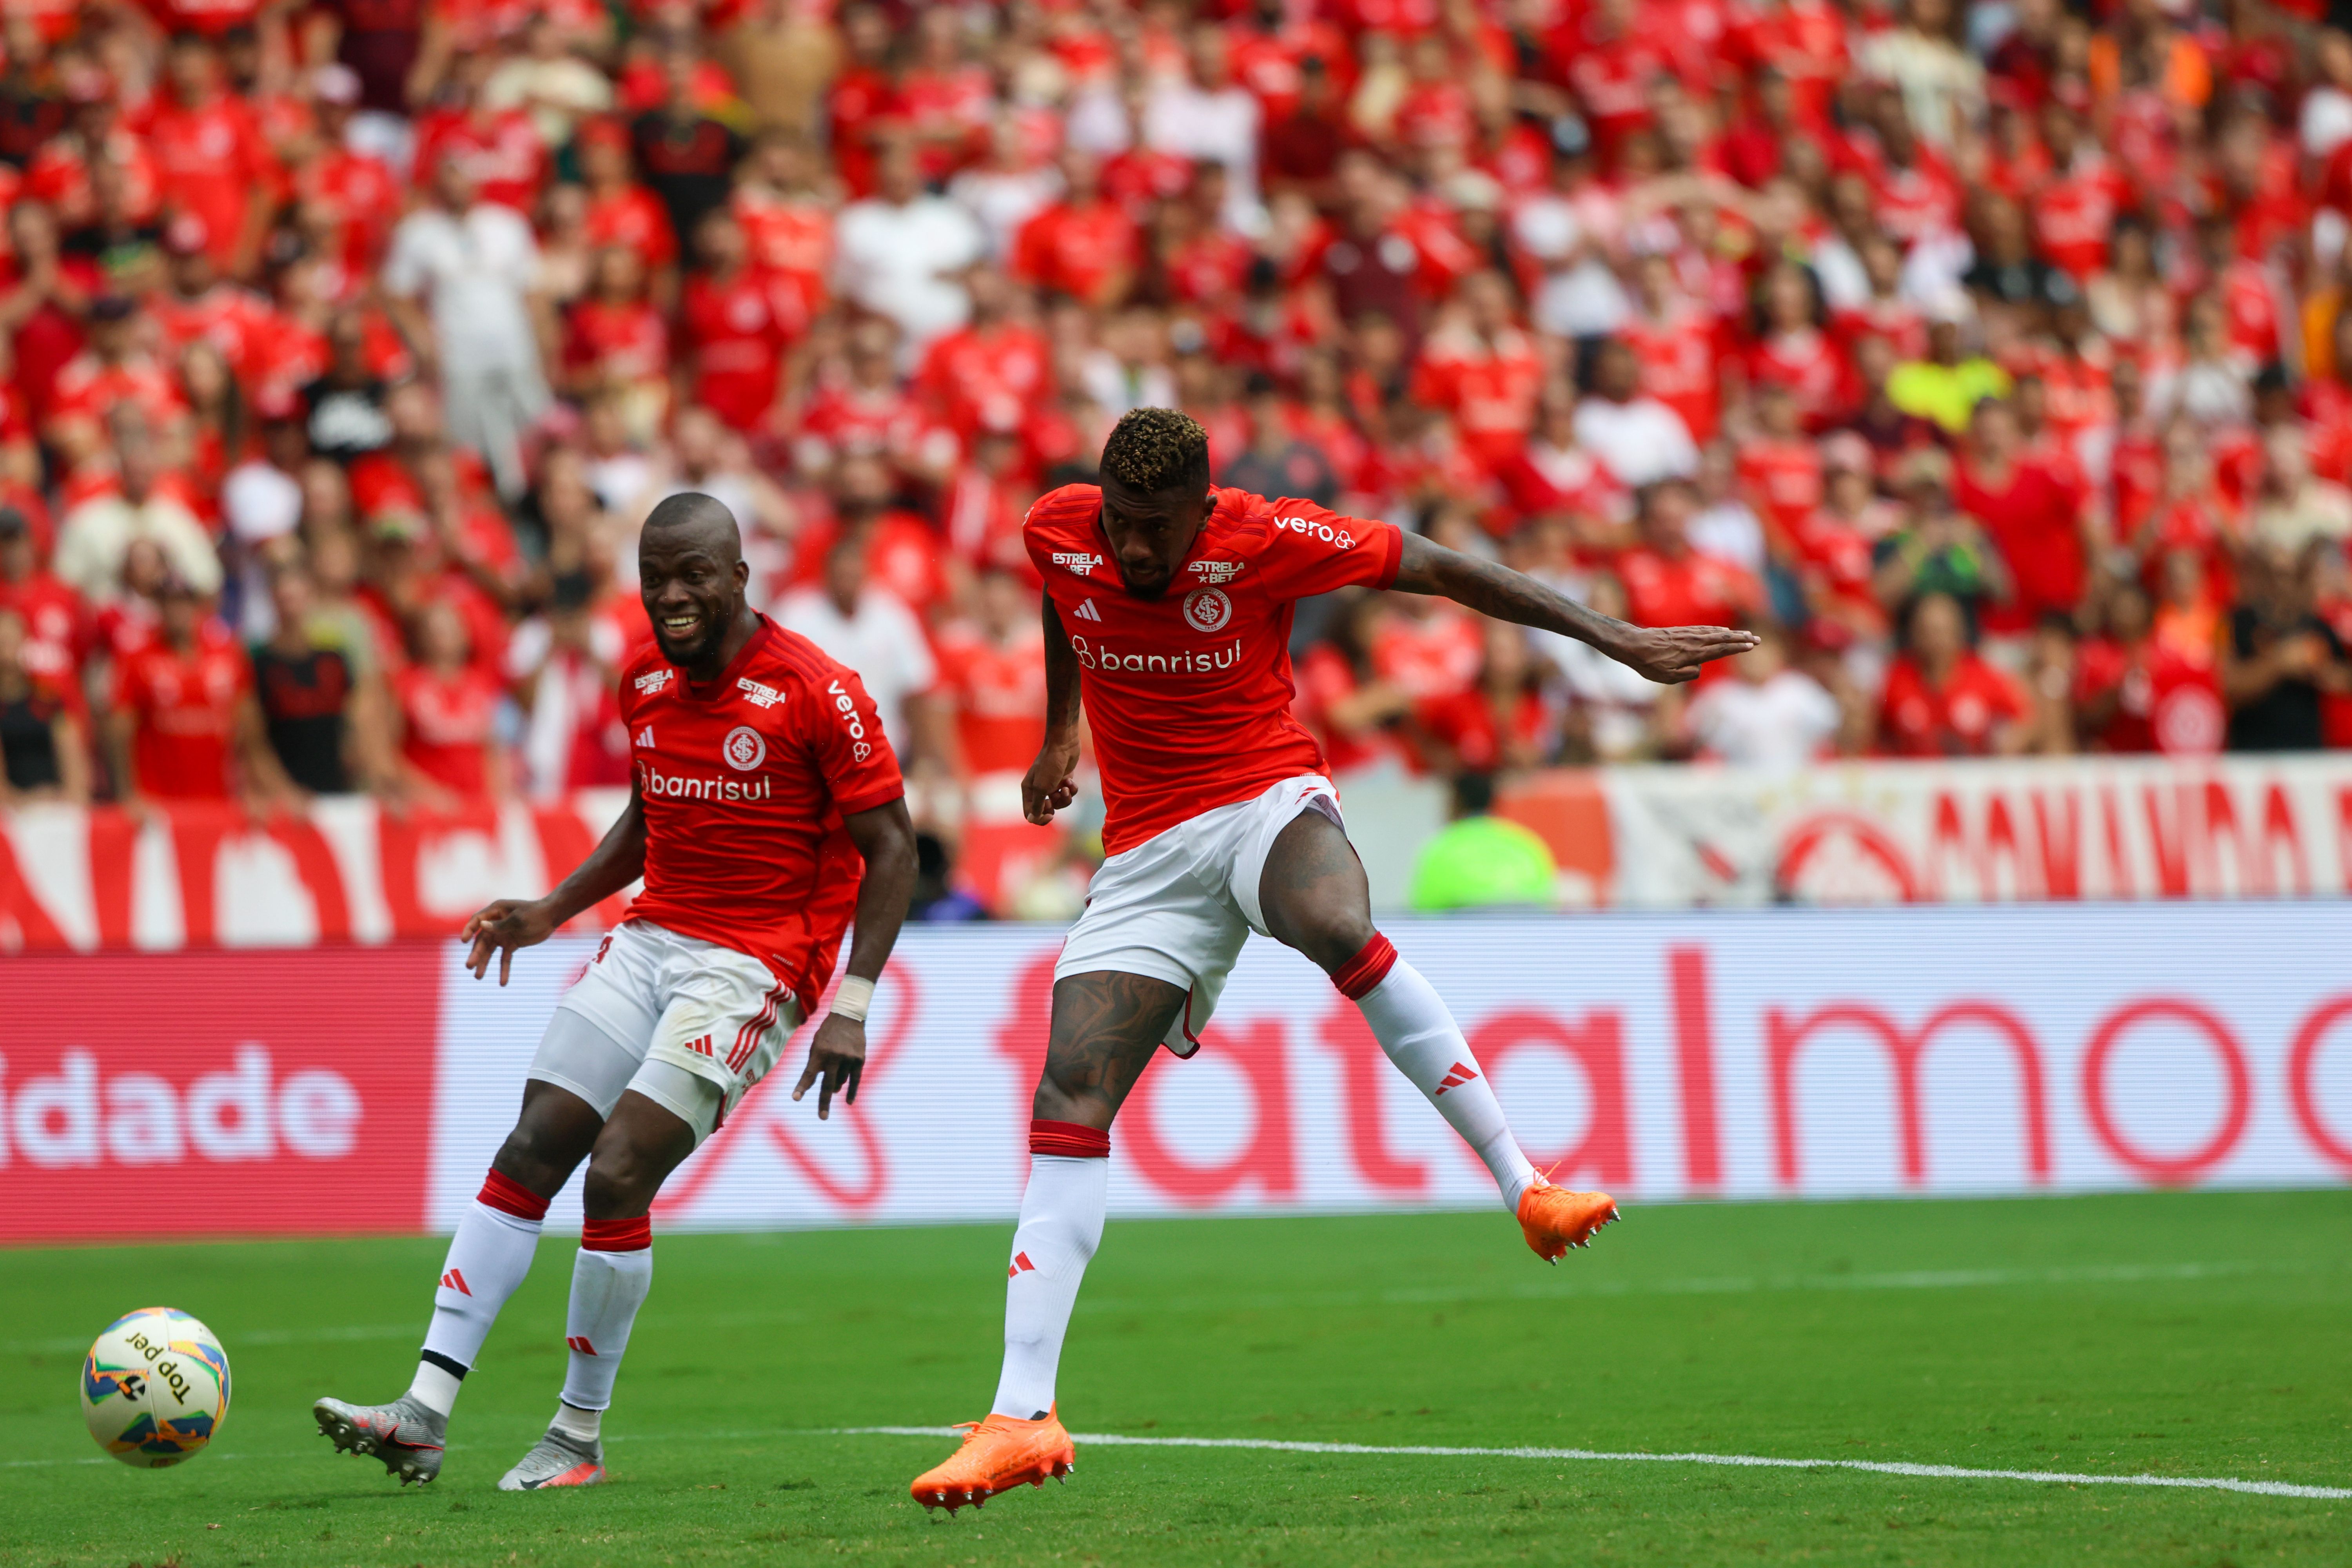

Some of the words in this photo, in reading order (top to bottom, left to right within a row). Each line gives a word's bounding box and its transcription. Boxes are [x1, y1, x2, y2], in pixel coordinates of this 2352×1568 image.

[1274, 516, 1334, 542] vero
[1052, 552, 1103, 565] ESTRELA
[1187, 561, 1245, 573] ESTRELA
[1069, 564, 1094, 576] BET
[1209, 572, 1236, 584] BET
[1100, 639, 1240, 673] banrisul
[634, 668, 674, 690] ESTRELA
[646, 681, 666, 695] BET
[737, 677, 786, 704] ESTRELA
[750, 693, 776, 710] BET
[828, 679, 864, 739] vero
[651, 767, 770, 800] banrisul
